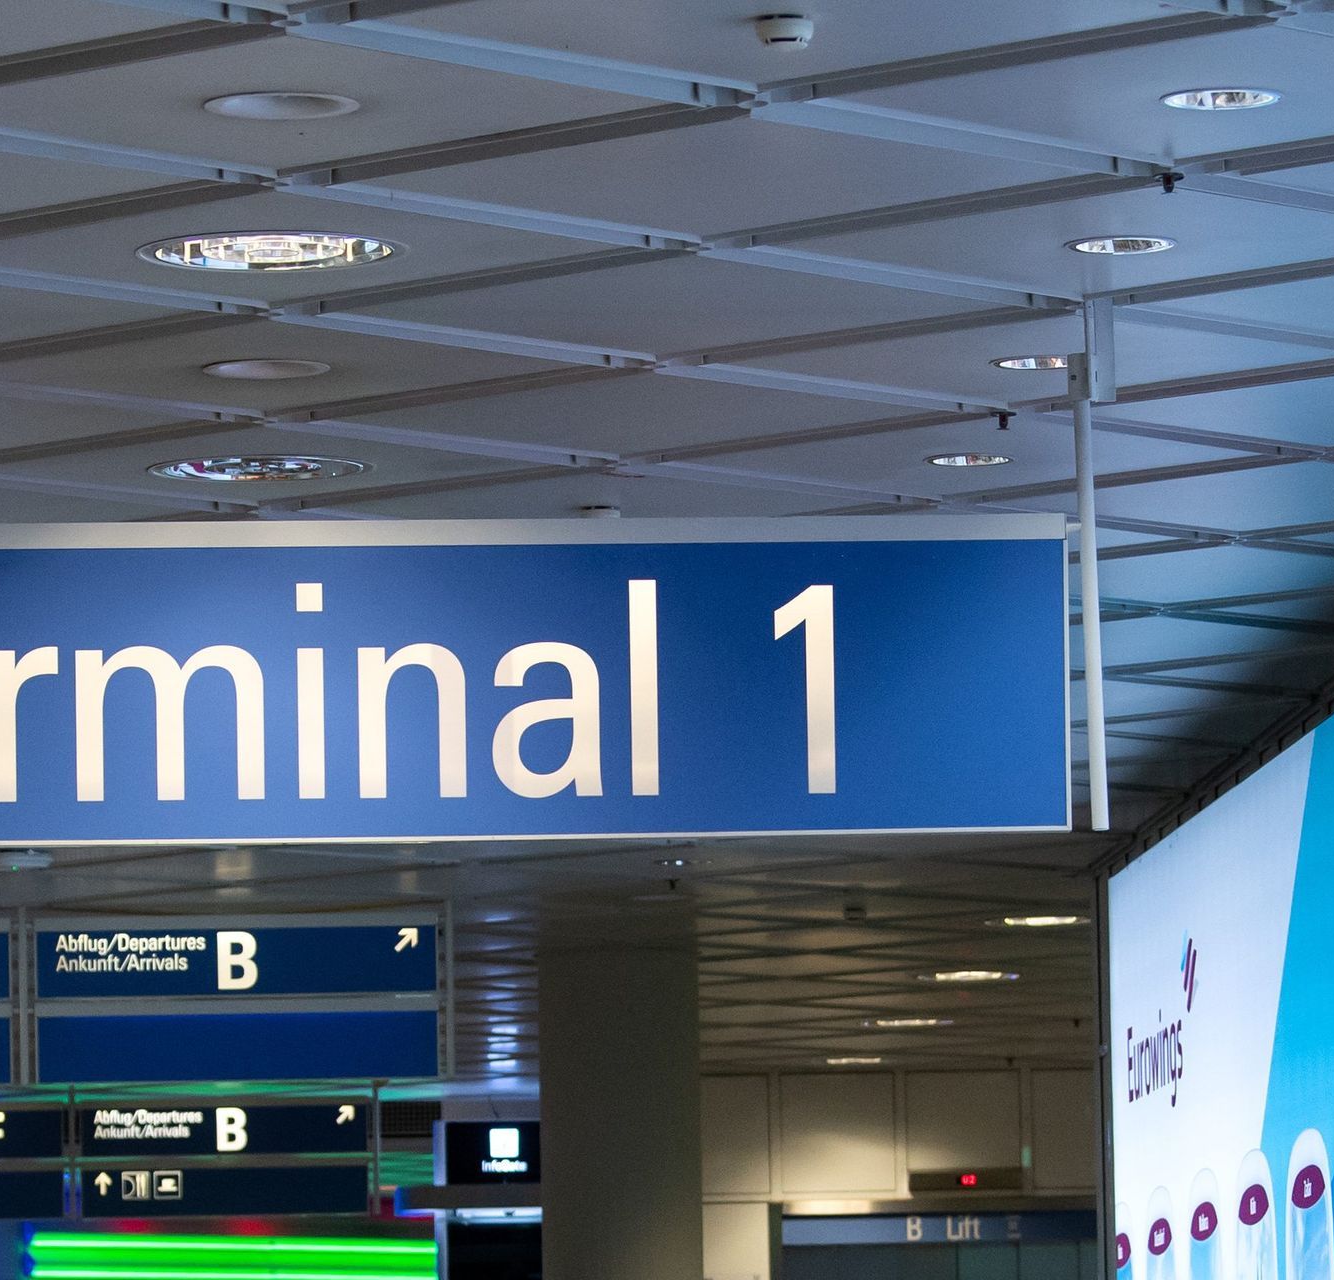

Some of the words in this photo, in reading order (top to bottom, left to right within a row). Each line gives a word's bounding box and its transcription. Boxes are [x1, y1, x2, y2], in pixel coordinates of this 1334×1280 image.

[773, 584, 836, 794] 1
[55, 932, 207, 955] Abflug/Departures
[216, 930, 259, 991] B
[55, 953, 189, 972] Ankunft/Arrivals
[1127, 1009, 1183, 1108] Eurowings
[93, 1108, 203, 1125] Abflug/Departures
[215, 1106, 248, 1152] B
[94, 1122, 191, 1139] Ankunft/Arrivals
[906, 1216, 923, 1242] B
[946, 1216, 981, 1241] Lift
